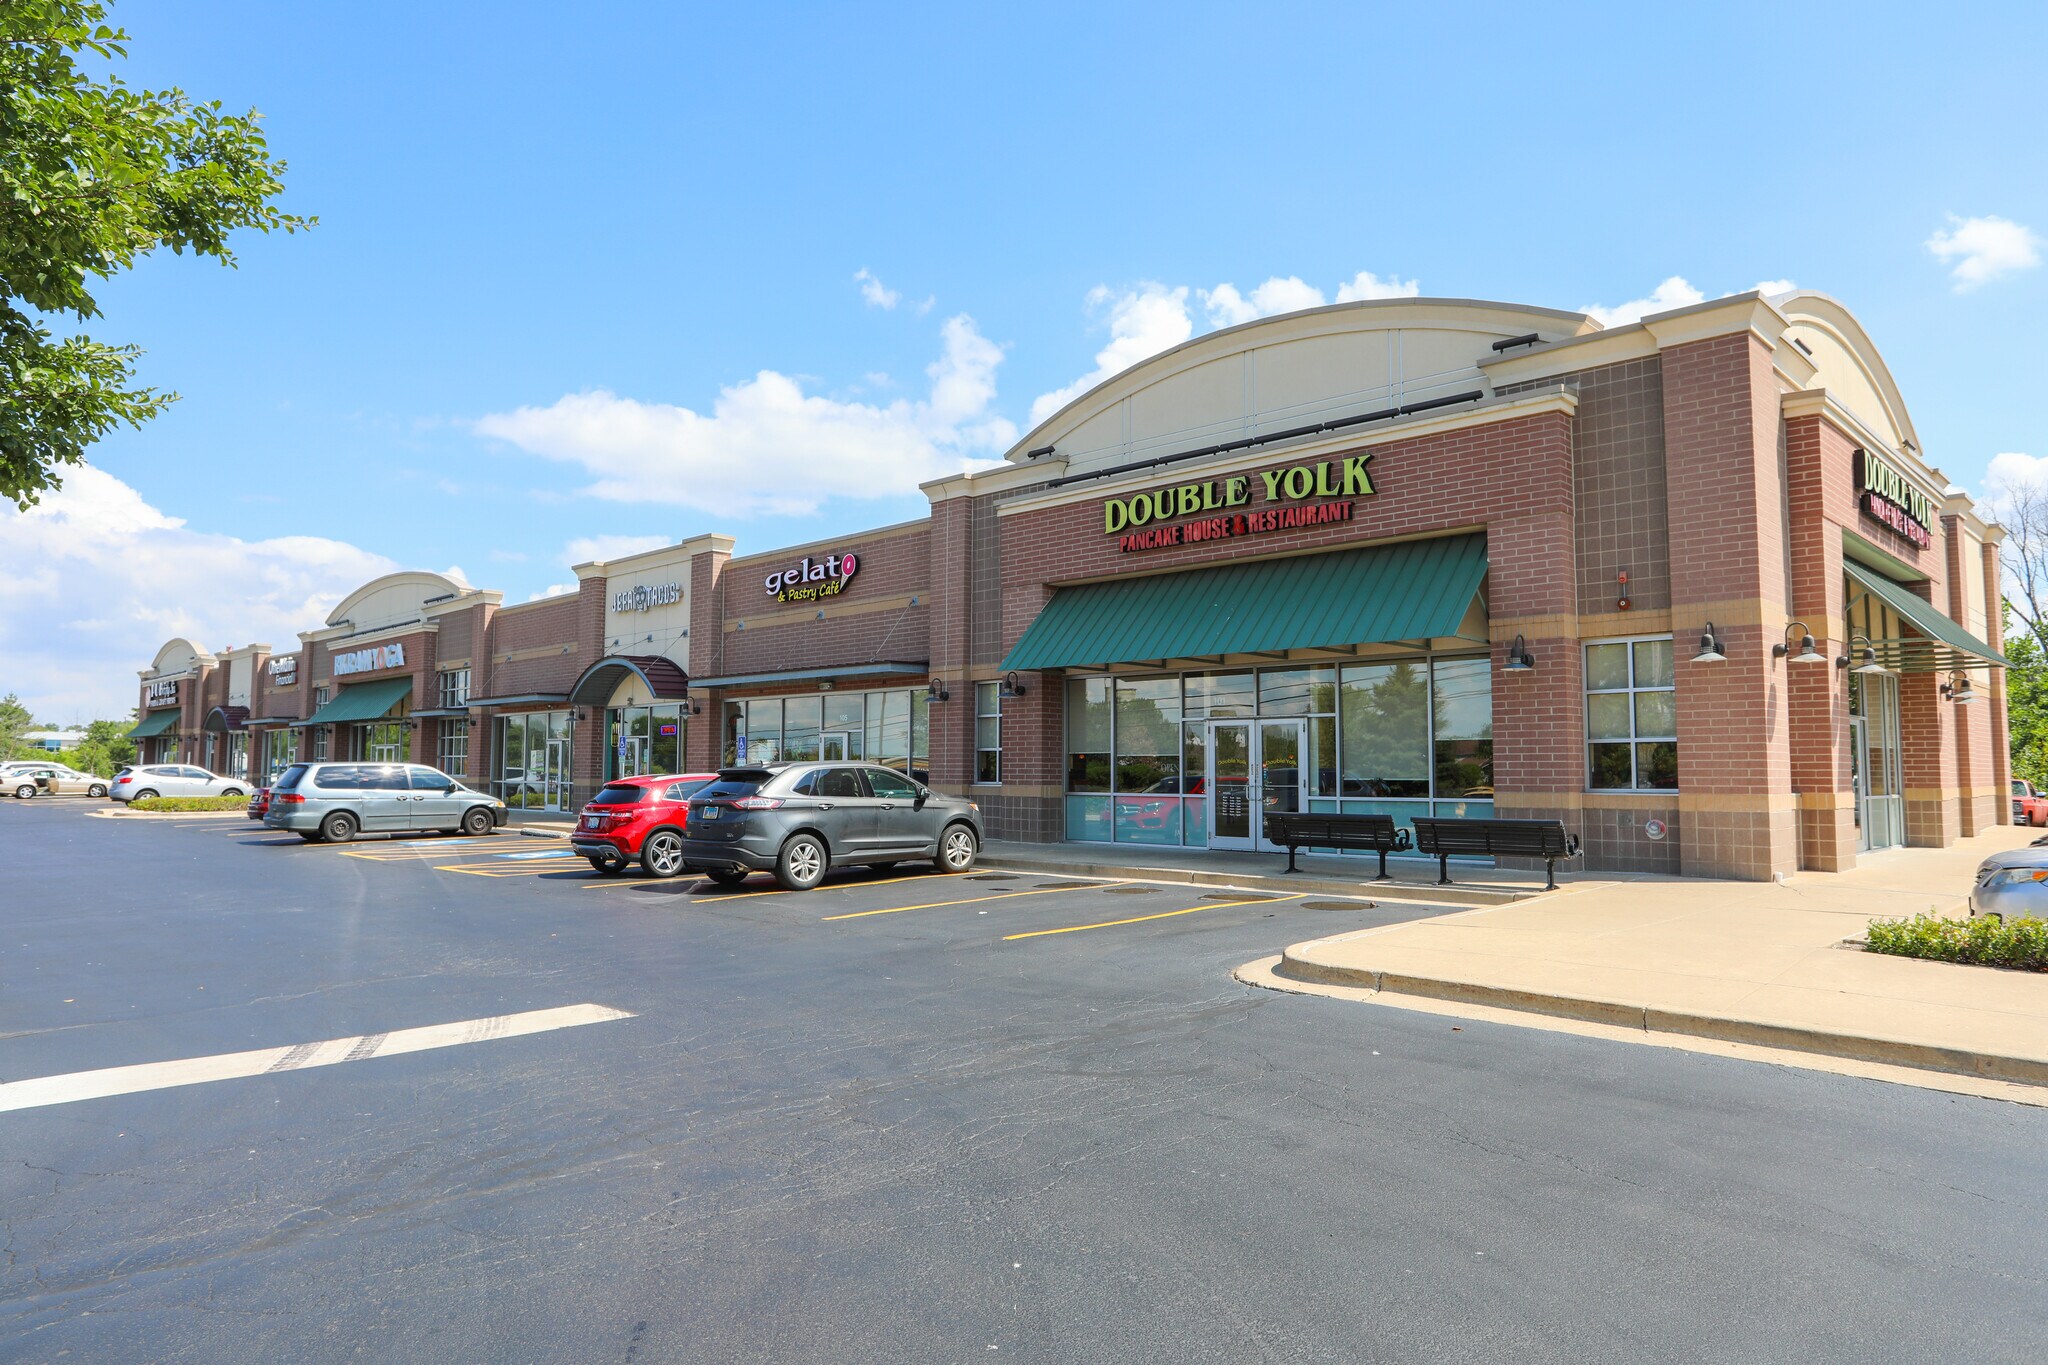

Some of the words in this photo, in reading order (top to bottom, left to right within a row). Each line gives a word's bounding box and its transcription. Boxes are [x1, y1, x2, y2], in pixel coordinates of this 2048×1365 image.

[1104, 475, 1248, 534] DOUBLE
[1259, 454, 1375, 502] YOLK
[1865, 449, 1908, 510] DOUBLE
[1908, 485, 1934, 536] YOLK
[1119, 526, 1181, 553] PANCAKE
[1183, 519, 1230, 543] HOUSE
[1233, 514, 1246, 535] &
[1248, 501, 1354, 534] RESTAURANT
[765, 553, 857, 596] gelato
[777, 590, 786, 603] &
[788, 588, 817, 602] Pastry
[819, 580, 840, 596] Café
[611, 590, 634, 613] JEFA
[645, 582, 676, 607] TACOS
[372, 642, 405, 670] YOGA
